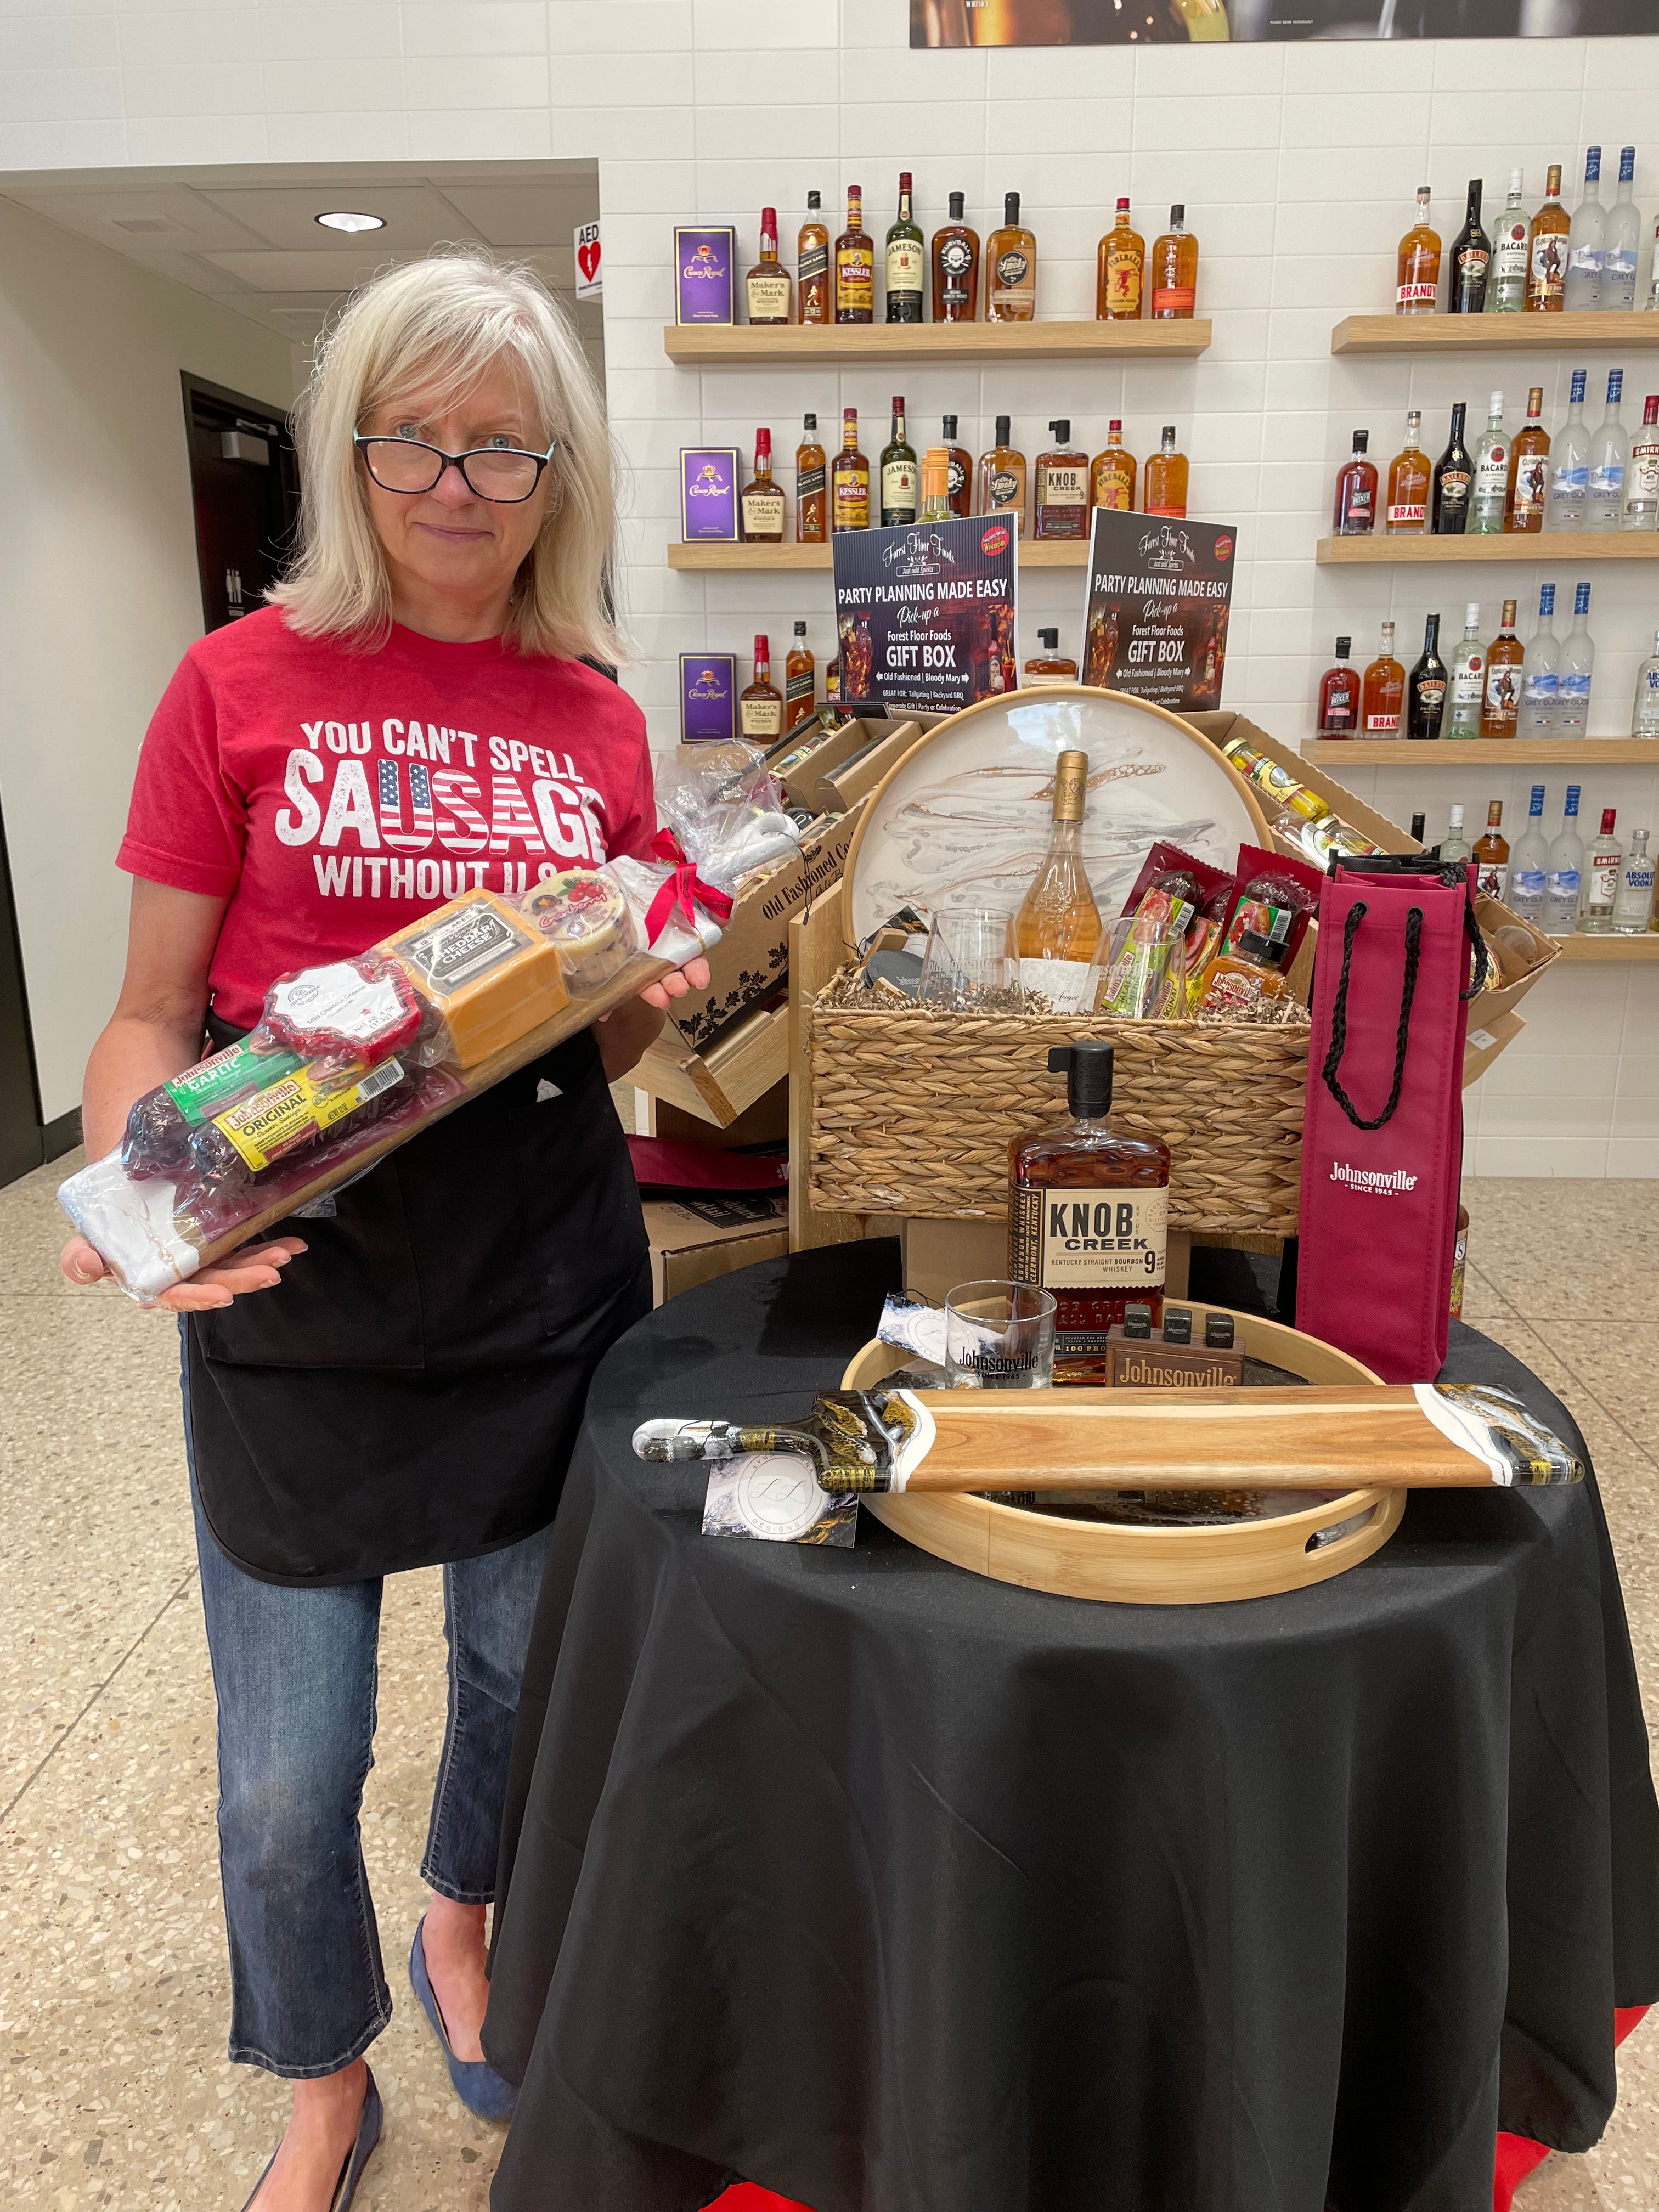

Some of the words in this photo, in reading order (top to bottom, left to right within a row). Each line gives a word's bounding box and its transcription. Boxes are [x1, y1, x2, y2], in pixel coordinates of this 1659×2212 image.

[579, 224, 599, 245] AED
[888, 244, 921, 256] JAMESON
[1461, 251, 1489, 262] BAILEYS
[1108, 254, 1141, 268] FIREBALL
[842, 267, 871, 277] KESSLER
[1401, 285, 1437, 300] BRANDY
[991, 478, 1018, 492] Smoky
[1049, 473, 1076, 486] KNOB
[1098, 473, 1131, 487] FIREBALL
[1441, 474, 1470, 484] BAILEYS
[708, 485, 730, 496] Royal
[839, 487, 867, 496] KESSLER
[1080, 491, 1084, 500] 9
[883, 541, 906, 567] Forest
[907, 532, 929, 554] Floor
[930, 533, 955, 563] Foods
[919, 565, 934, 574] Spirits
[839, 586, 873, 603] PARTY
[876, 584, 934, 602] PLANNING
[938, 582, 973, 599] MADE
[977, 579, 1007, 597] EASY
[1094, 574, 1125, 593] PARTY
[1127, 577, 1176, 596] PLANNING
[1178, 580, 1205, 596] MADE
[1206, 582, 1228, 598] EASY
[897, 605, 932, 628] Pick-up
[934, 607, 939, 617] a
[1143, 599, 1172, 622] Pick-up
[1173, 602, 1178, 612] a
[888, 631, 909, 641] Forest
[910, 630, 929, 641] Floor
[930, 629, 951, 640] Foods
[1132, 625, 1150, 635] Forest
[1152, 625, 1166, 636] Floor
[1167, 625, 1183, 636] Foods
[887, 646, 919, 667] GIFT
[923, 645, 956, 667] BOX
[1128, 640, 1156, 663] GIFT
[1158, 640, 1185, 663] BOX
[884, 673, 893, 681] Old
[894, 673, 921, 681] Fashioned
[925, 674, 945, 684] Bloody
[946, 674, 960, 684] Mary
[1131, 669, 1153, 678] Fashioned
[1157, 668, 1172, 678] Bloody
[1173, 668, 1184, 678] Mary
[1419, 680, 1446, 690] BAILEYS
[706, 689, 727, 700] Royal
[909, 691, 930, 699] Tailgating
[933, 691, 953, 699] Backyard
[918, 703, 929, 712] Party
[300, 721, 371, 755] YOU
[382, 718, 478, 768] CAN'T
[488, 736, 583, 783] SPELL
[275, 748, 606, 865] SAUSAGE
[313, 855, 489, 899] WITHOUT
[1629, 879, 1654, 887] VODKA
[762, 895, 786, 921] Old
[781, 851, 838, 905] Fashioned
[539, 893, 608, 928] Cranberry
[451, 914, 472, 928] AGED
[442, 933, 493, 964] CHEESE
[302, 984, 321, 998] CHEESE
[1050, 991, 1079, 1003] Angel
[307, 1015, 319, 1024] Mild
[320, 998, 345, 1015] Cheddar
[344, 985, 365, 1000] Cheese
[354, 1023, 366, 1032] Net
[369, 1013, 392, 1029] (113g)
[177, 1046, 240, 1085] Johnsonville
[188, 1057, 241, 1091] GARLIC
[195, 1081, 218, 1094] Summer
[219, 1069, 242, 1082] Sausage
[232, 1083, 297, 1127] Johnsonville
[242, 1094, 307, 1137] ORIGINAL
[256, 1122, 279, 1138] Summer
[279, 1108, 302, 1125] Sausage
[289, 1133, 302, 1144] FILLERS
[271, 1149, 283, 1160] GOOD
[282, 1142, 296, 1152] SOURCE
[1330, 1161, 1415, 1191] Johnsonville
[1350, 1183, 1373, 1193] SINCE
[1375, 1187, 1392, 1196] 1945
[1031, 1193, 1039, 1236] KENTUCKY
[1050, 1202, 1133, 1238] KNOB
[1064, 1238, 1149, 1251] CREEK
[1030, 1239, 1039, 1283] CLERMONT,
[1144, 1250, 1156, 1274] 9
[960, 1346, 1039, 1373] Johnsonville
[977, 1372, 1000, 1380] SINCE
[1119, 1358, 1235, 1387] Johnsonville
[752, 1518, 800, 1532] DESIGNS
